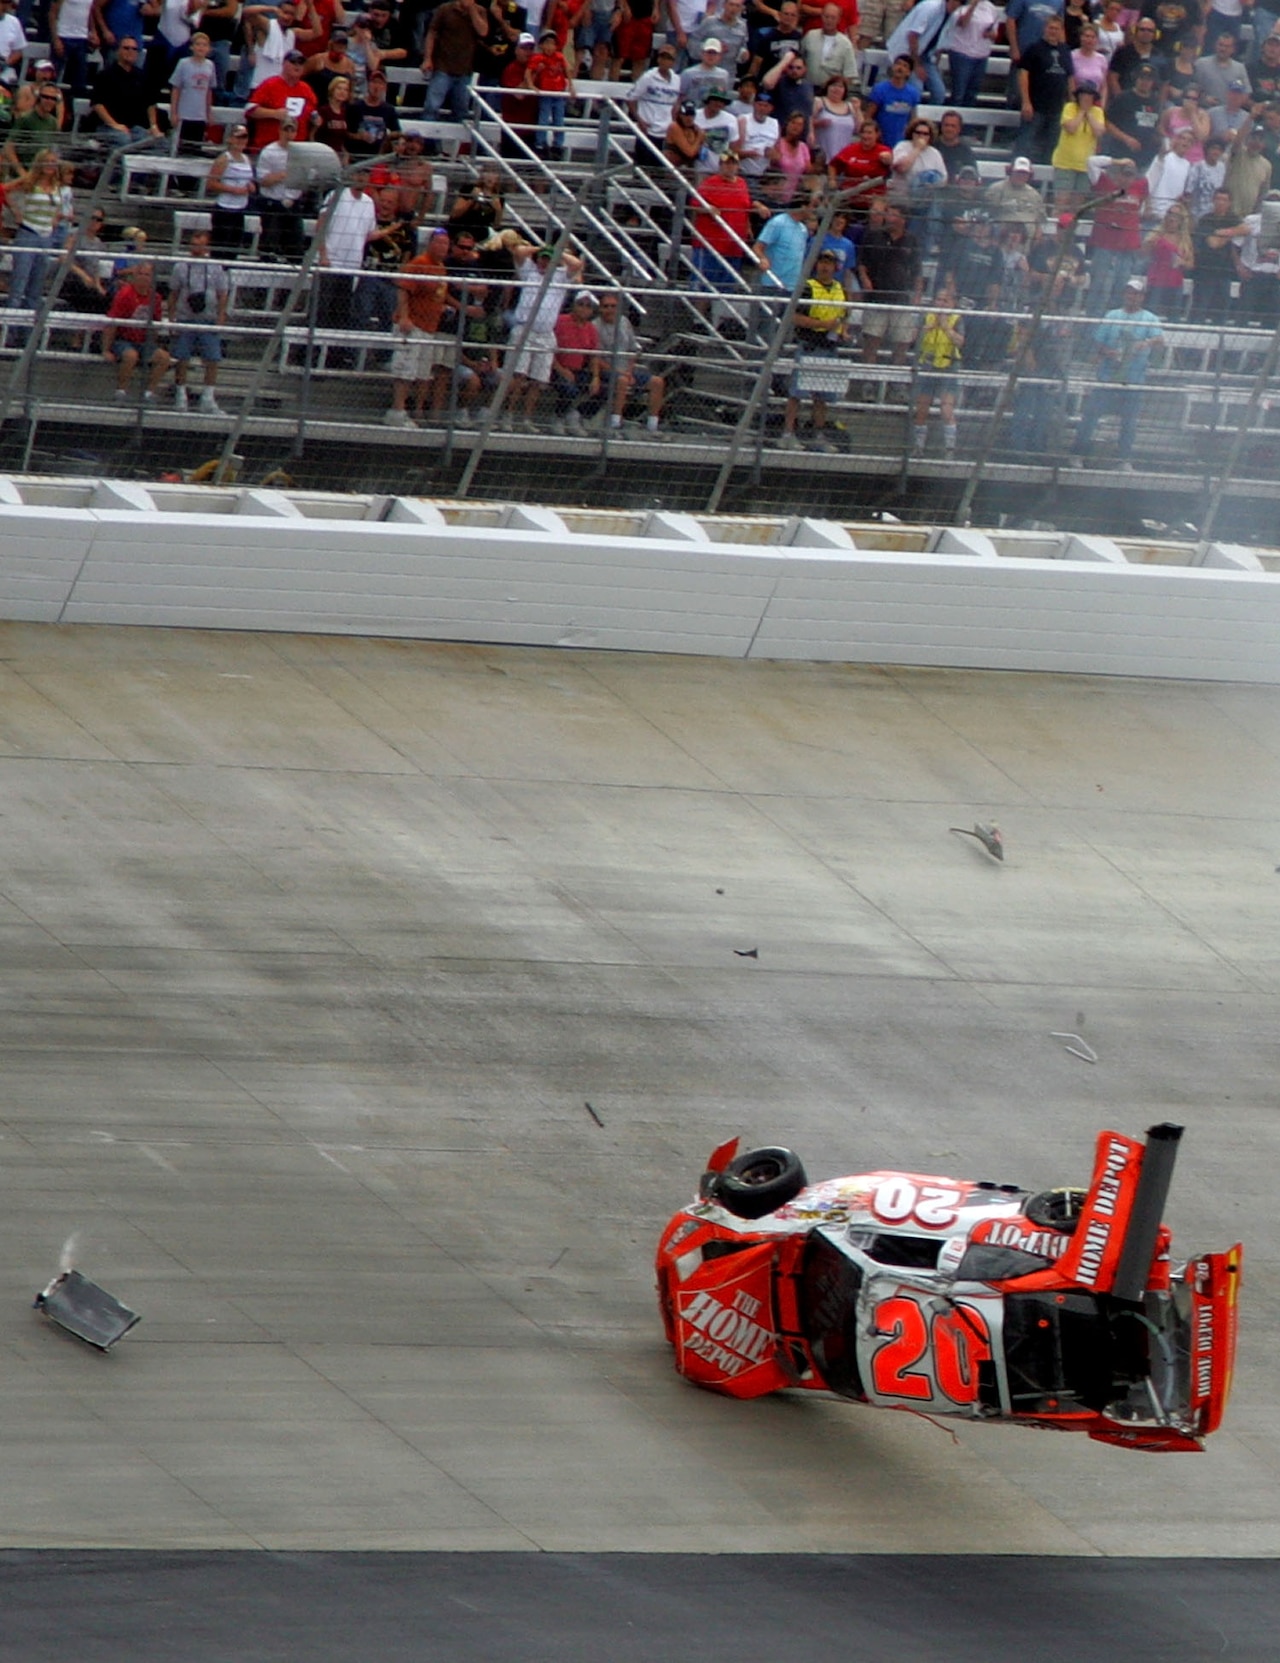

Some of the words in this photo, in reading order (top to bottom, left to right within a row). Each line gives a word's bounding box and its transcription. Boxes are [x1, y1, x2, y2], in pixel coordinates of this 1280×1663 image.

[873, 1177, 960, 1228] 20
[1075, 1220, 1111, 1286] HOME
[1093, 1138, 1130, 1216] DEPOT
[681, 1291, 775, 1365] HOME
[731, 1289, 763, 1319] THE
[1198, 1304, 1213, 1352] DEPOT
[683, 1332, 746, 1377] DEPOT
[872, 1296, 992, 1406] 20
[1197, 1355, 1212, 1398] HOME
